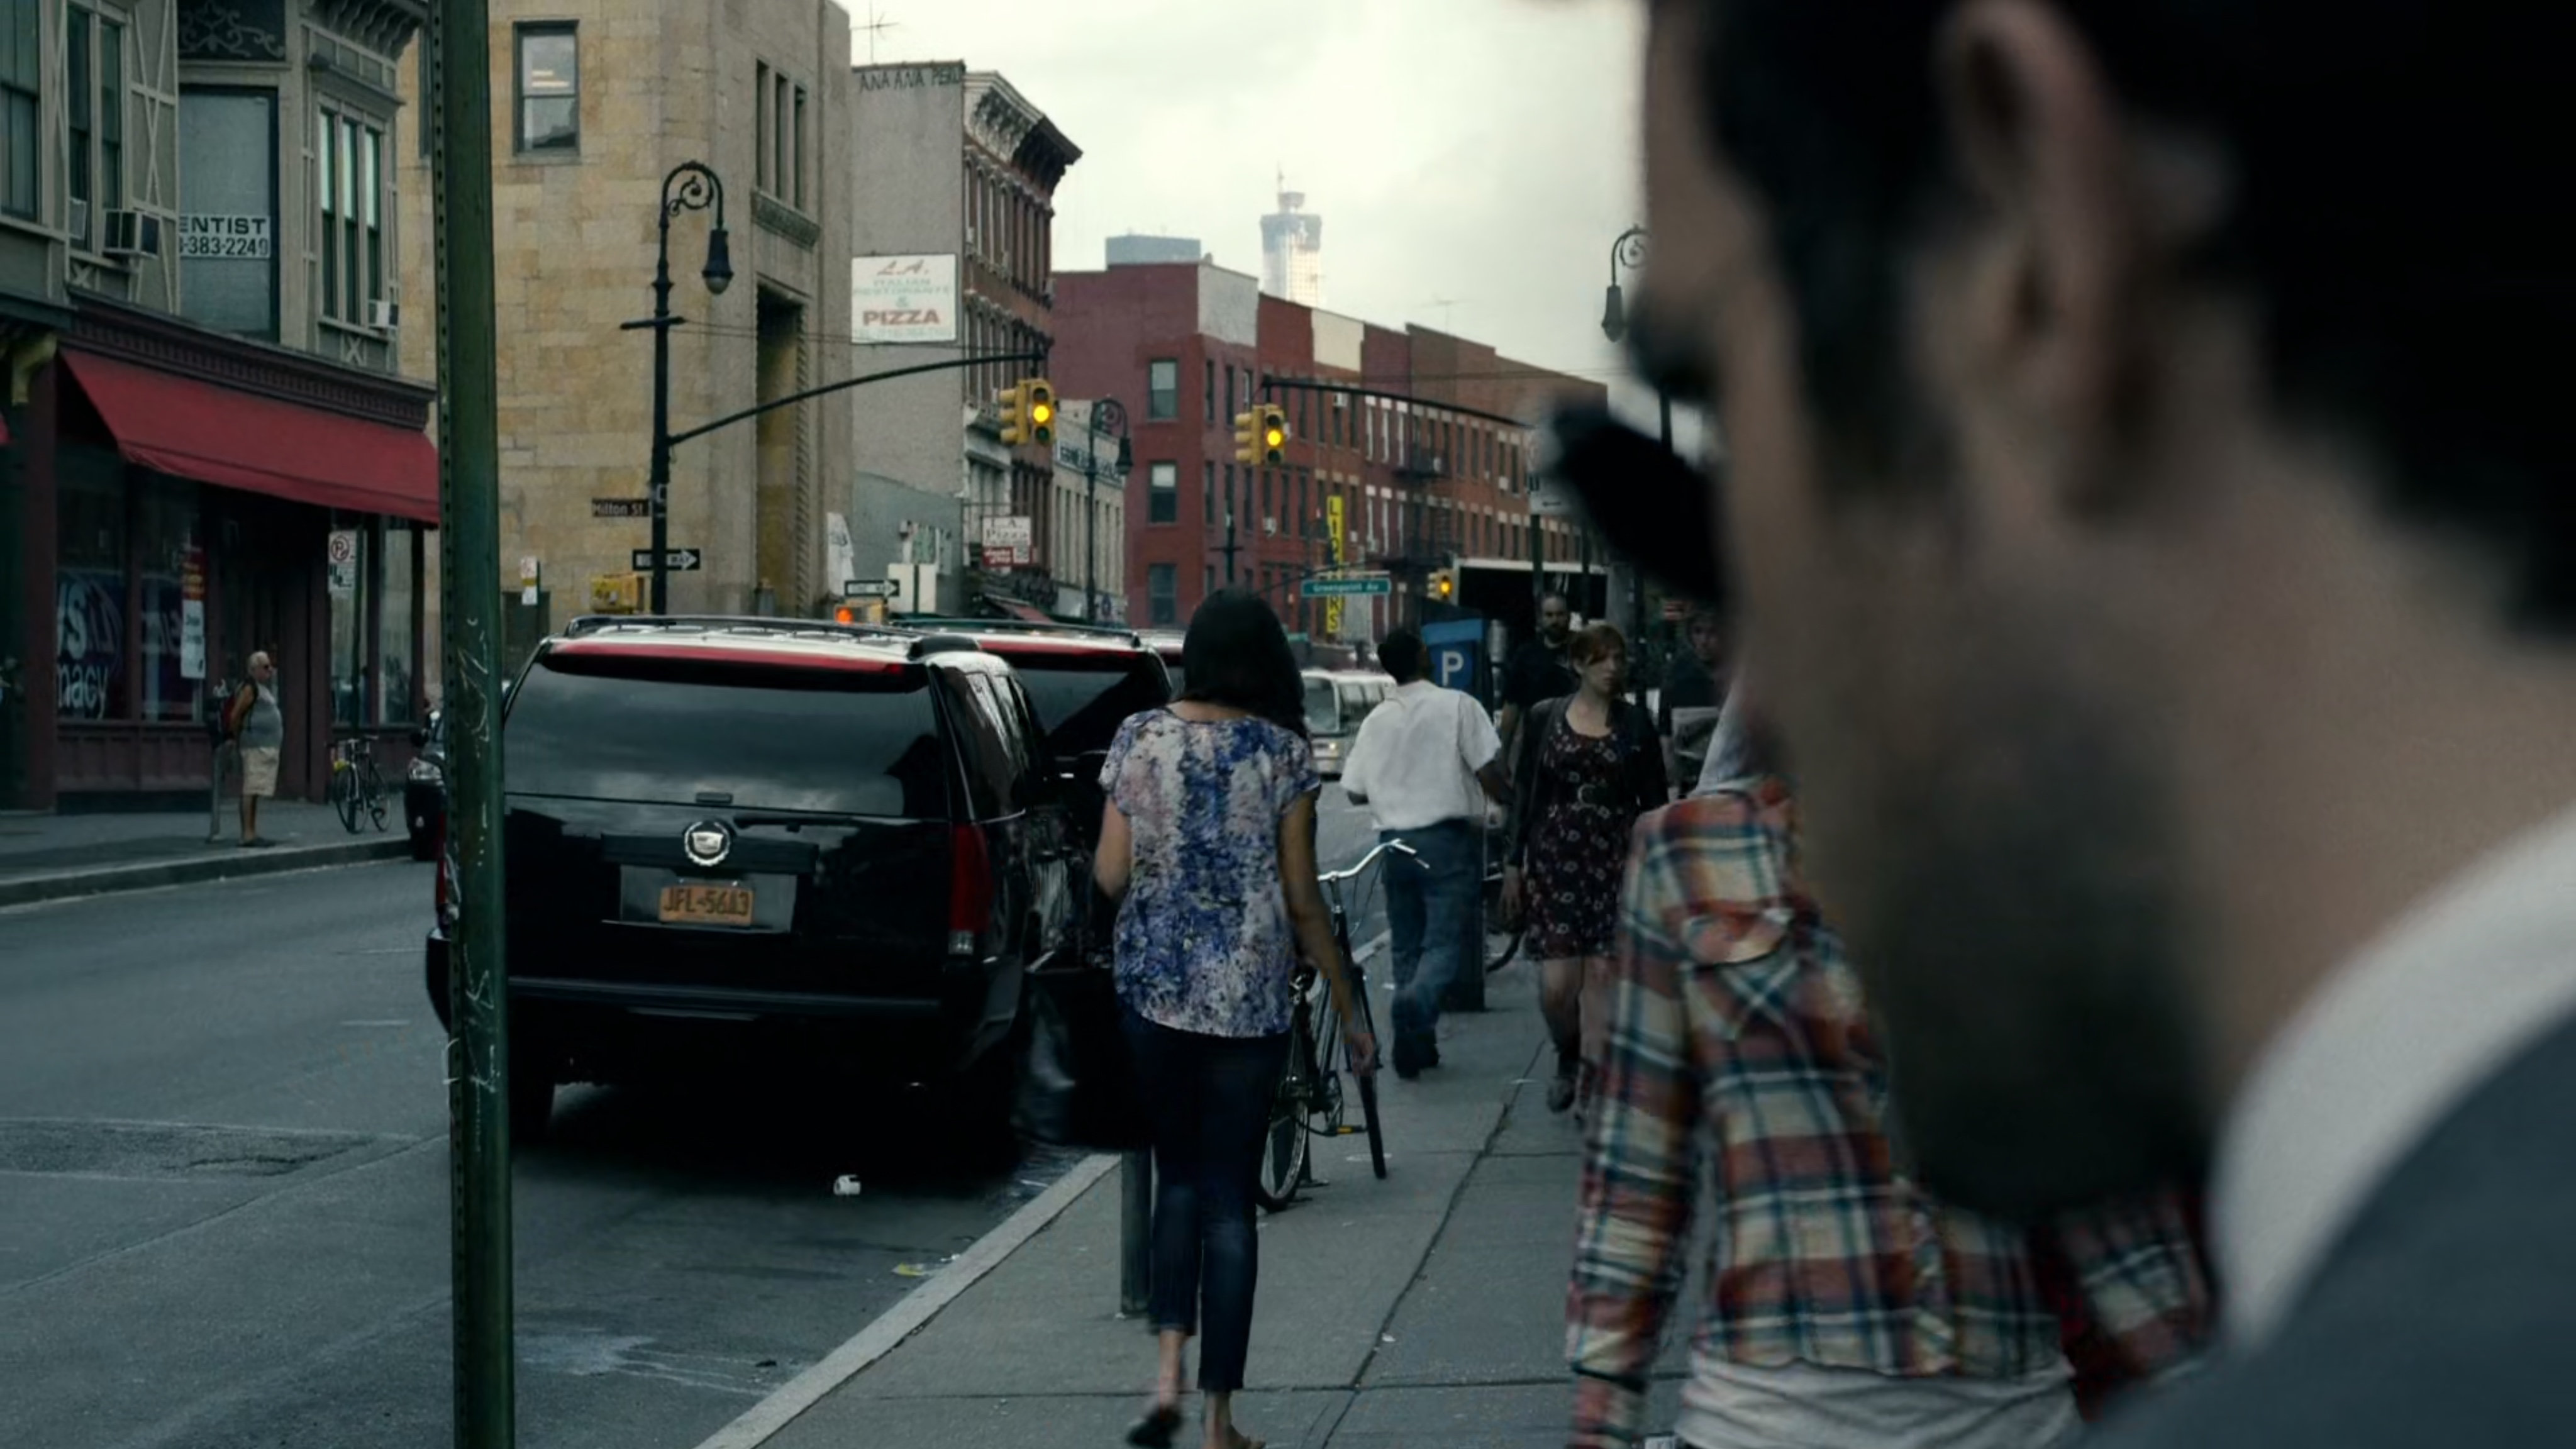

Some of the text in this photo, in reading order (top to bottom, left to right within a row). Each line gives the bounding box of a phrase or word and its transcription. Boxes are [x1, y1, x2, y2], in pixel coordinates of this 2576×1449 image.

[863, 309, 940, 324] PIZZA
[631, 504, 643, 515] St
[1443, 651, 1464, 687] P
